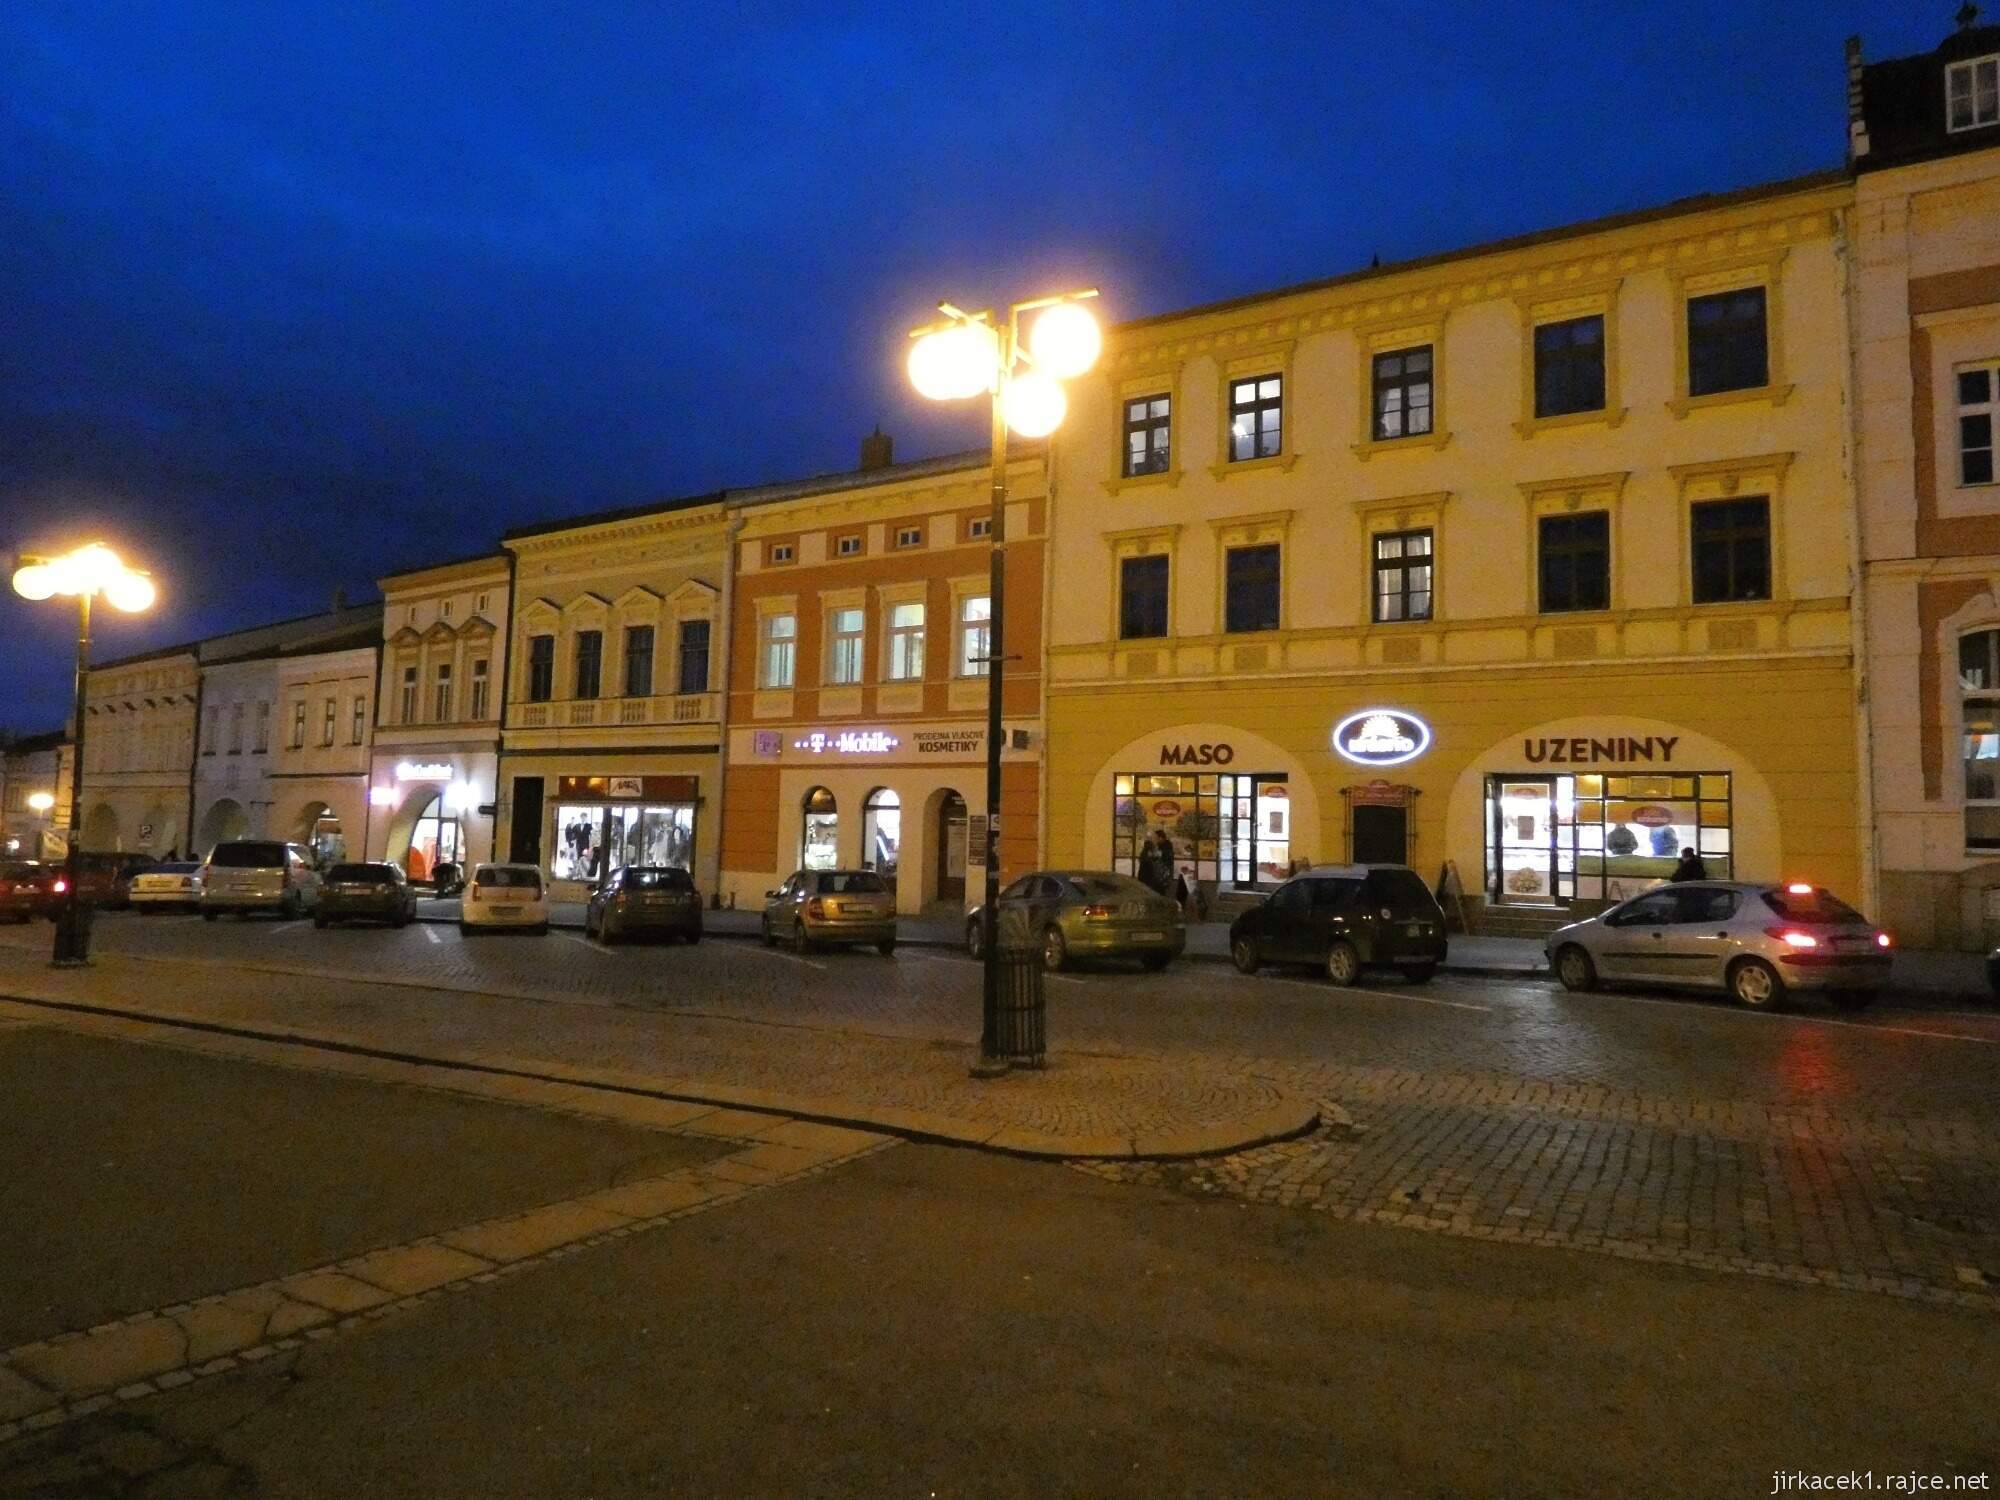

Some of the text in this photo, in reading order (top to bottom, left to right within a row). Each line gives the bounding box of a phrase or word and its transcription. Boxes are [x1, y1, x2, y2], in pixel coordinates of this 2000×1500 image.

[918, 741, 978, 753] KOSMETIKY
[1160, 743, 1234, 765] MASO
[1525, 736, 1679, 763] UZENINY
